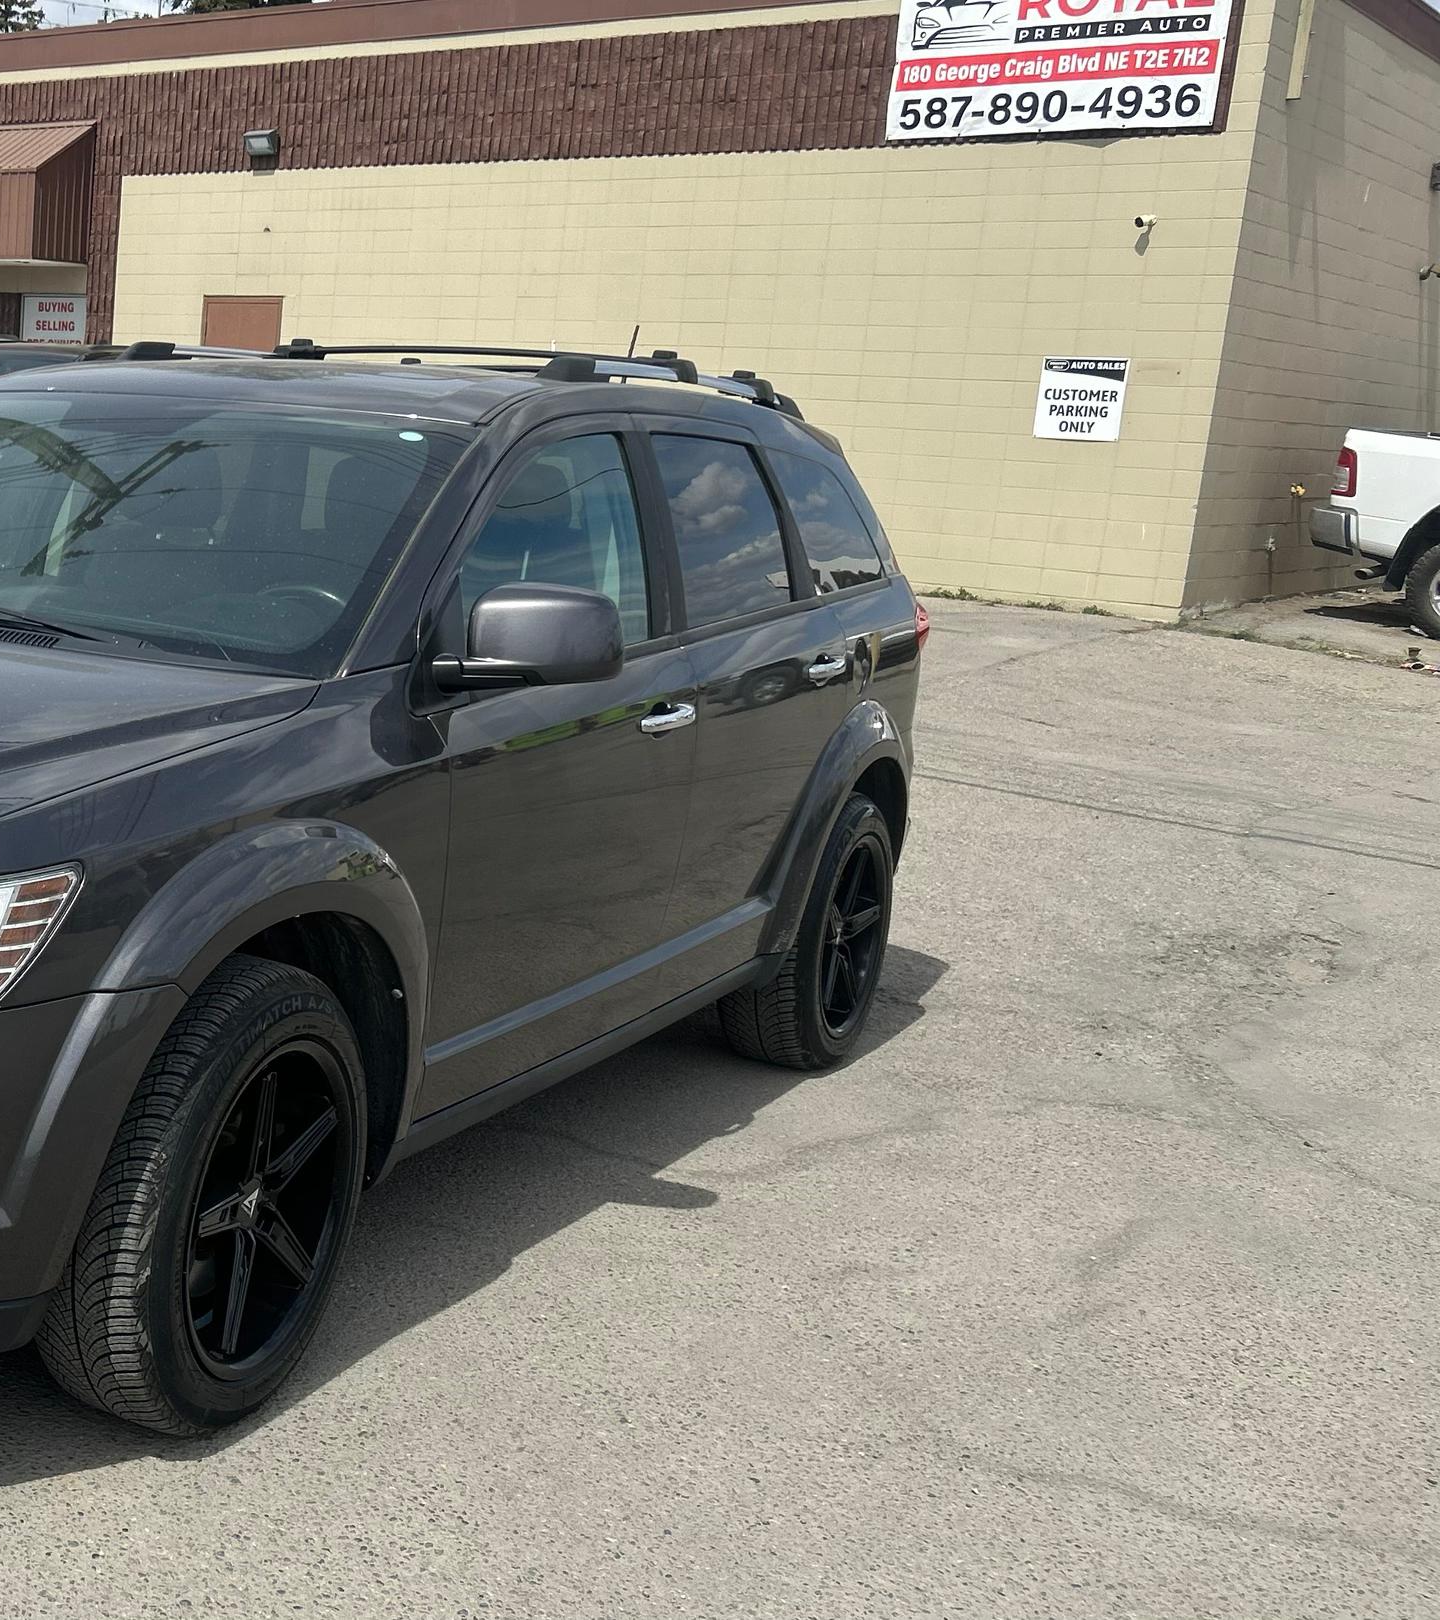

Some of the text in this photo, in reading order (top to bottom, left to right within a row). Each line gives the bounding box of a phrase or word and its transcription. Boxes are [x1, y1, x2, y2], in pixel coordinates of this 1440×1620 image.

[1018, 17, 1207, 41] PREMIER AUTO
[902, 47, 1210, 84] 180 George Craig Blvd NE T2E 7H2
[899, 83, 1202, 130] 587-890-4936
[38, 302, 74, 313] BUYING
[35, 320, 76, 332] SELLING
[1070, 361, 1095, 370] AUTO
[1097, 362, 1126, 371] SALES
[1044, 388, 1118, 402] CUSTOMER
[1049, 404, 1109, 418] PARKING
[1058, 420, 1096, 434] ONLY
